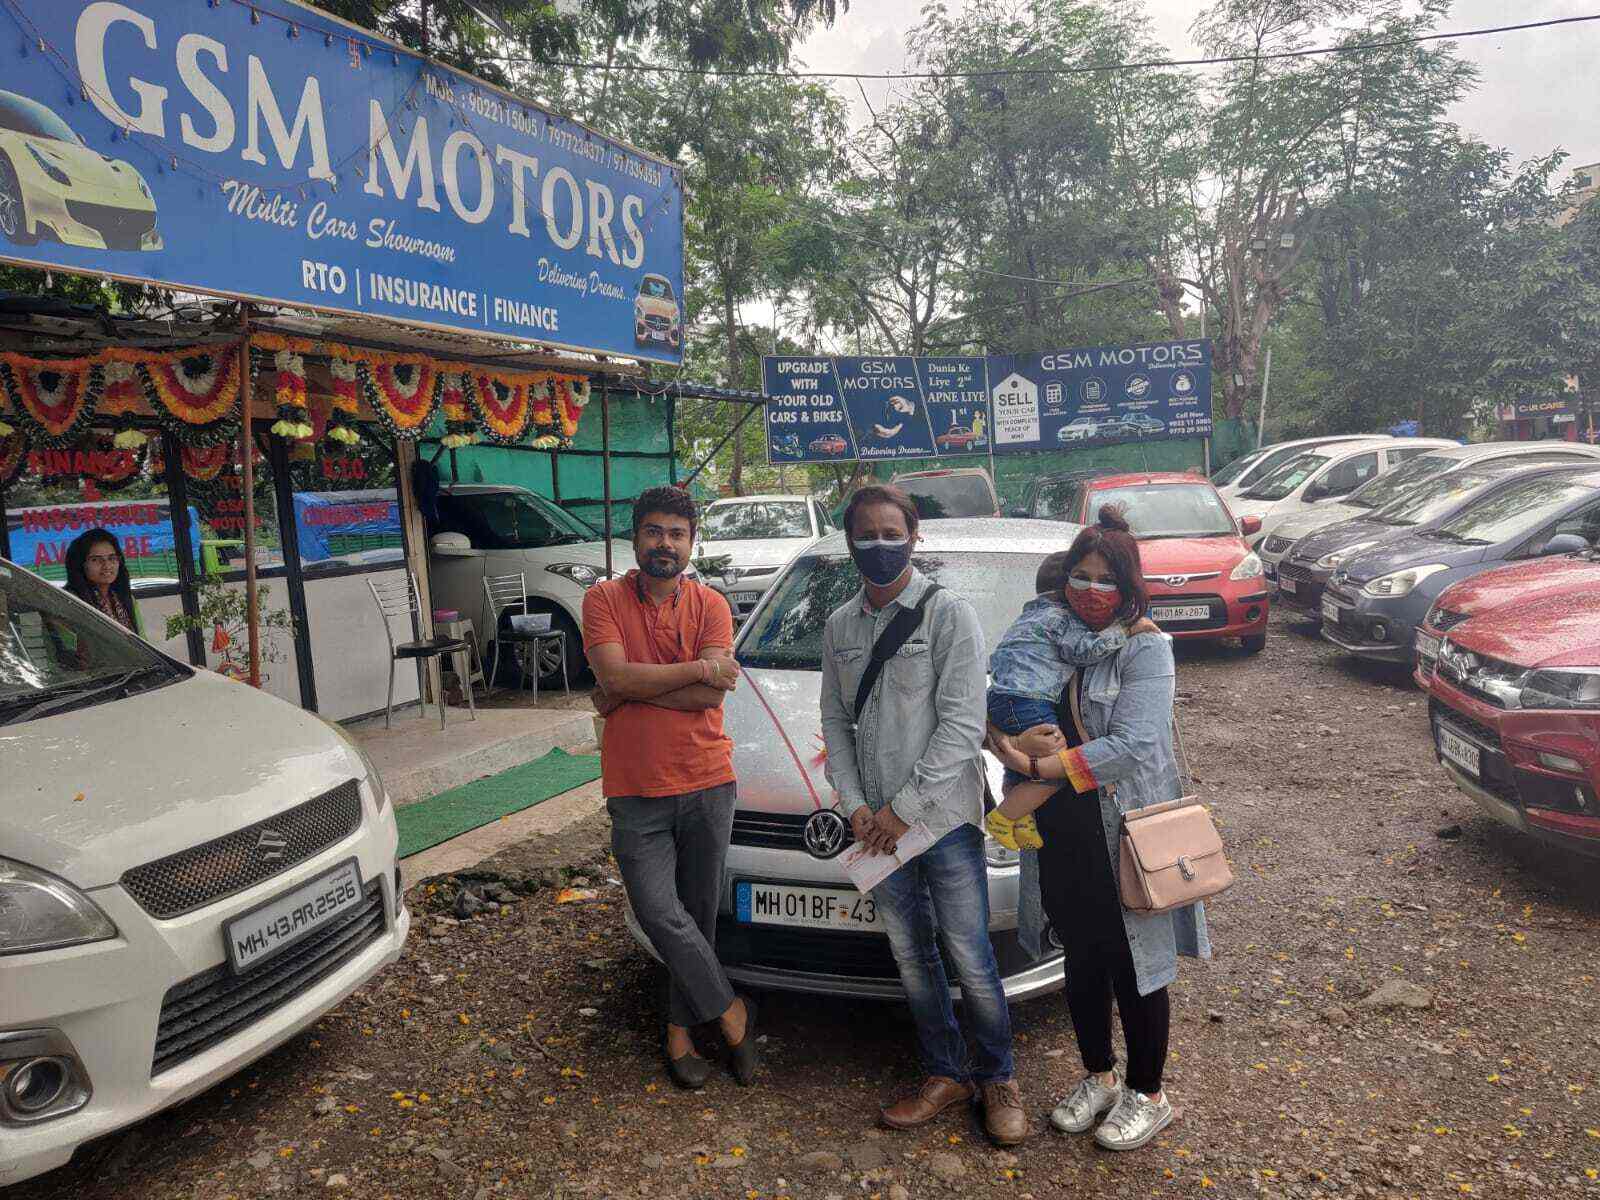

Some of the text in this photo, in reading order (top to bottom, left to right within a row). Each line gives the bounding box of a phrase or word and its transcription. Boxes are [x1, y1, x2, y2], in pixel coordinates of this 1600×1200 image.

[75, 2, 645, 269] GSM MOTORS
[222, 180, 456, 263] Multi Cars Showroom
[538, 257, 588, 298] Delivering
[302, 259, 559, 331] RTO INSURANCE FINANCE
[1041, 344, 1202, 370] GSM MOTORS
[778, 362, 829, 374] UPGRADE
[861, 362, 897, 374] GSM
[959, 363, 970, 373] Ke
[791, 379, 818, 390] WITH
[844, 377, 914, 389] MOTORS
[811, 395, 833, 406] OLD
[928, 391, 986, 402] APNE LIYE
[998, 392, 1032, 406] SELL
[770, 411, 843, 423] CARS & BIKES
[23, 503, 160, 532] INSURANCE
[756, 891, 780, 916] MH
[812, 896, 837, 919] BF
